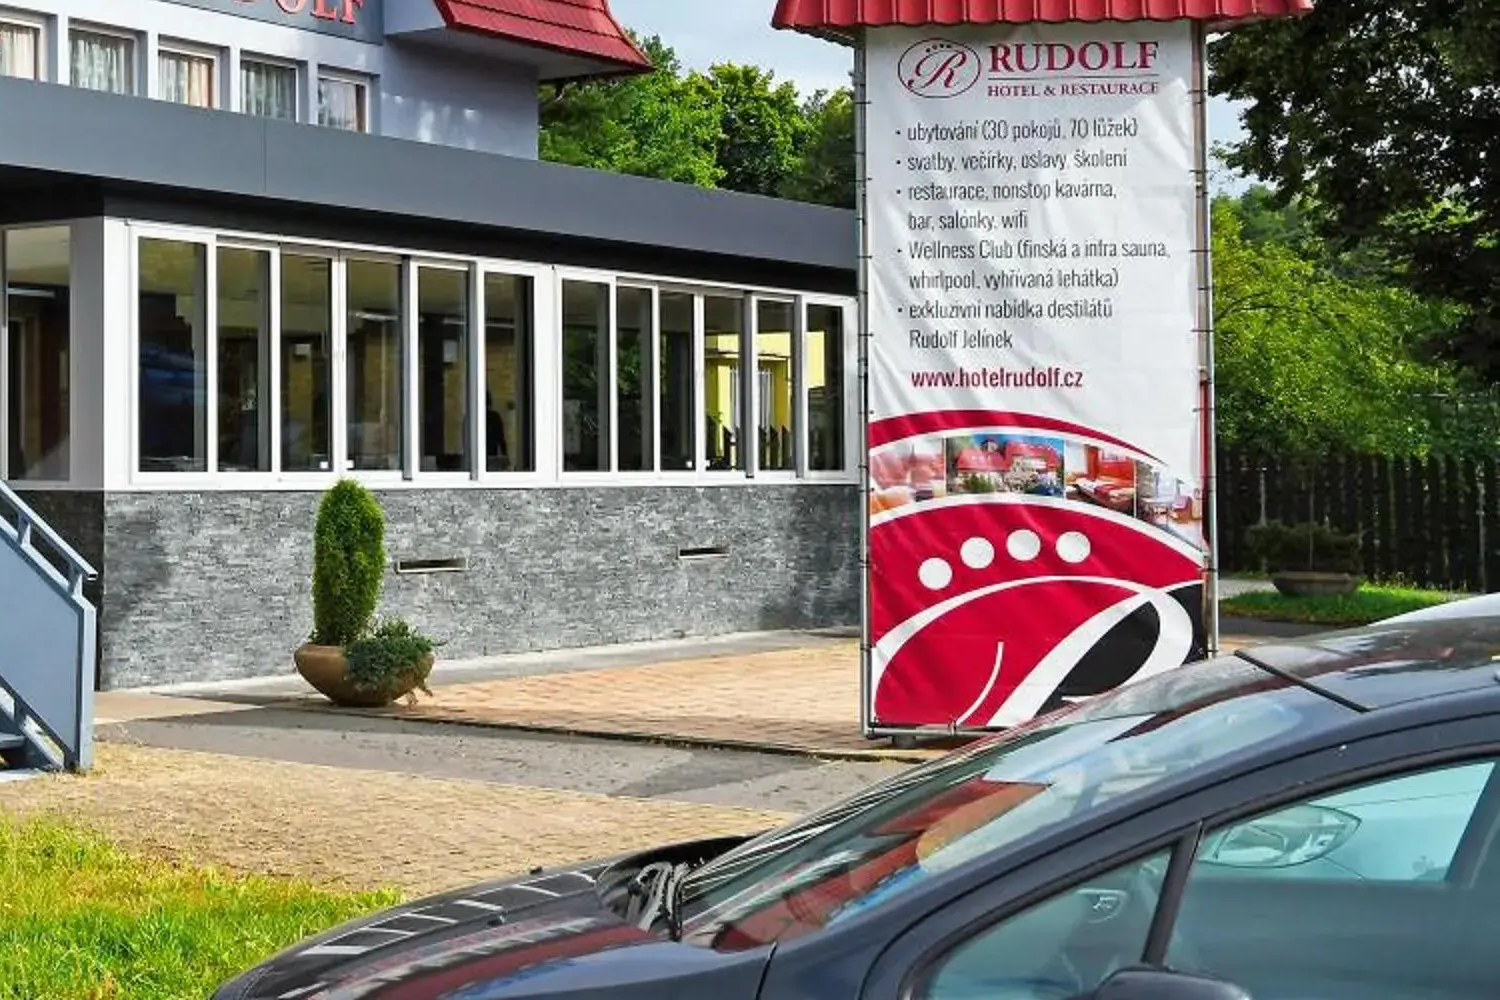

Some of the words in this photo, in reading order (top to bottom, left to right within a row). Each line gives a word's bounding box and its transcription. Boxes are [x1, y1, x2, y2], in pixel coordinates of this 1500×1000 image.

[988, 41, 1159, 73] RUDOLF
[987, 83, 1039, 97] HOTEL
[1043, 86, 1056, 97] &
[1060, 81, 1159, 96] RESTAURACE
[907, 120, 978, 143] ubytování
[982, 119, 1008, 141] (30
[1071, 118, 1089, 138] 70
[1093, 118, 1138, 138] lůžek)
[962, 151, 1017, 171] večírky,
[908, 183, 989, 201] restaurace,
[994, 182, 1050, 200] nonstop
[1055, 179, 1116, 199] kavárna,
[908, 213, 935, 231] bar,
[1001, 210, 1028, 229] wifi
[909, 240, 975, 259] Wellness
[979, 239, 1012, 259] Club
[1017, 238, 1067, 259] (finská
[1072, 245, 1080, 258] a
[1085, 240, 1117, 258] infra
[1121, 242, 1170, 258] sauna,
[984, 268, 1053, 290] vyhřívaná
[1058, 267, 1119, 289] lehátka)
[909, 301, 980, 319] exkluzivní
[985, 300, 1043, 318] nabídka
[1048, 299, 1112, 318] destilátů
[909, 329, 958, 349] Rudolf
[962, 328, 1013, 349] Jelínek
[911, 367, 1083, 388] www.hotelrudolf.cz
